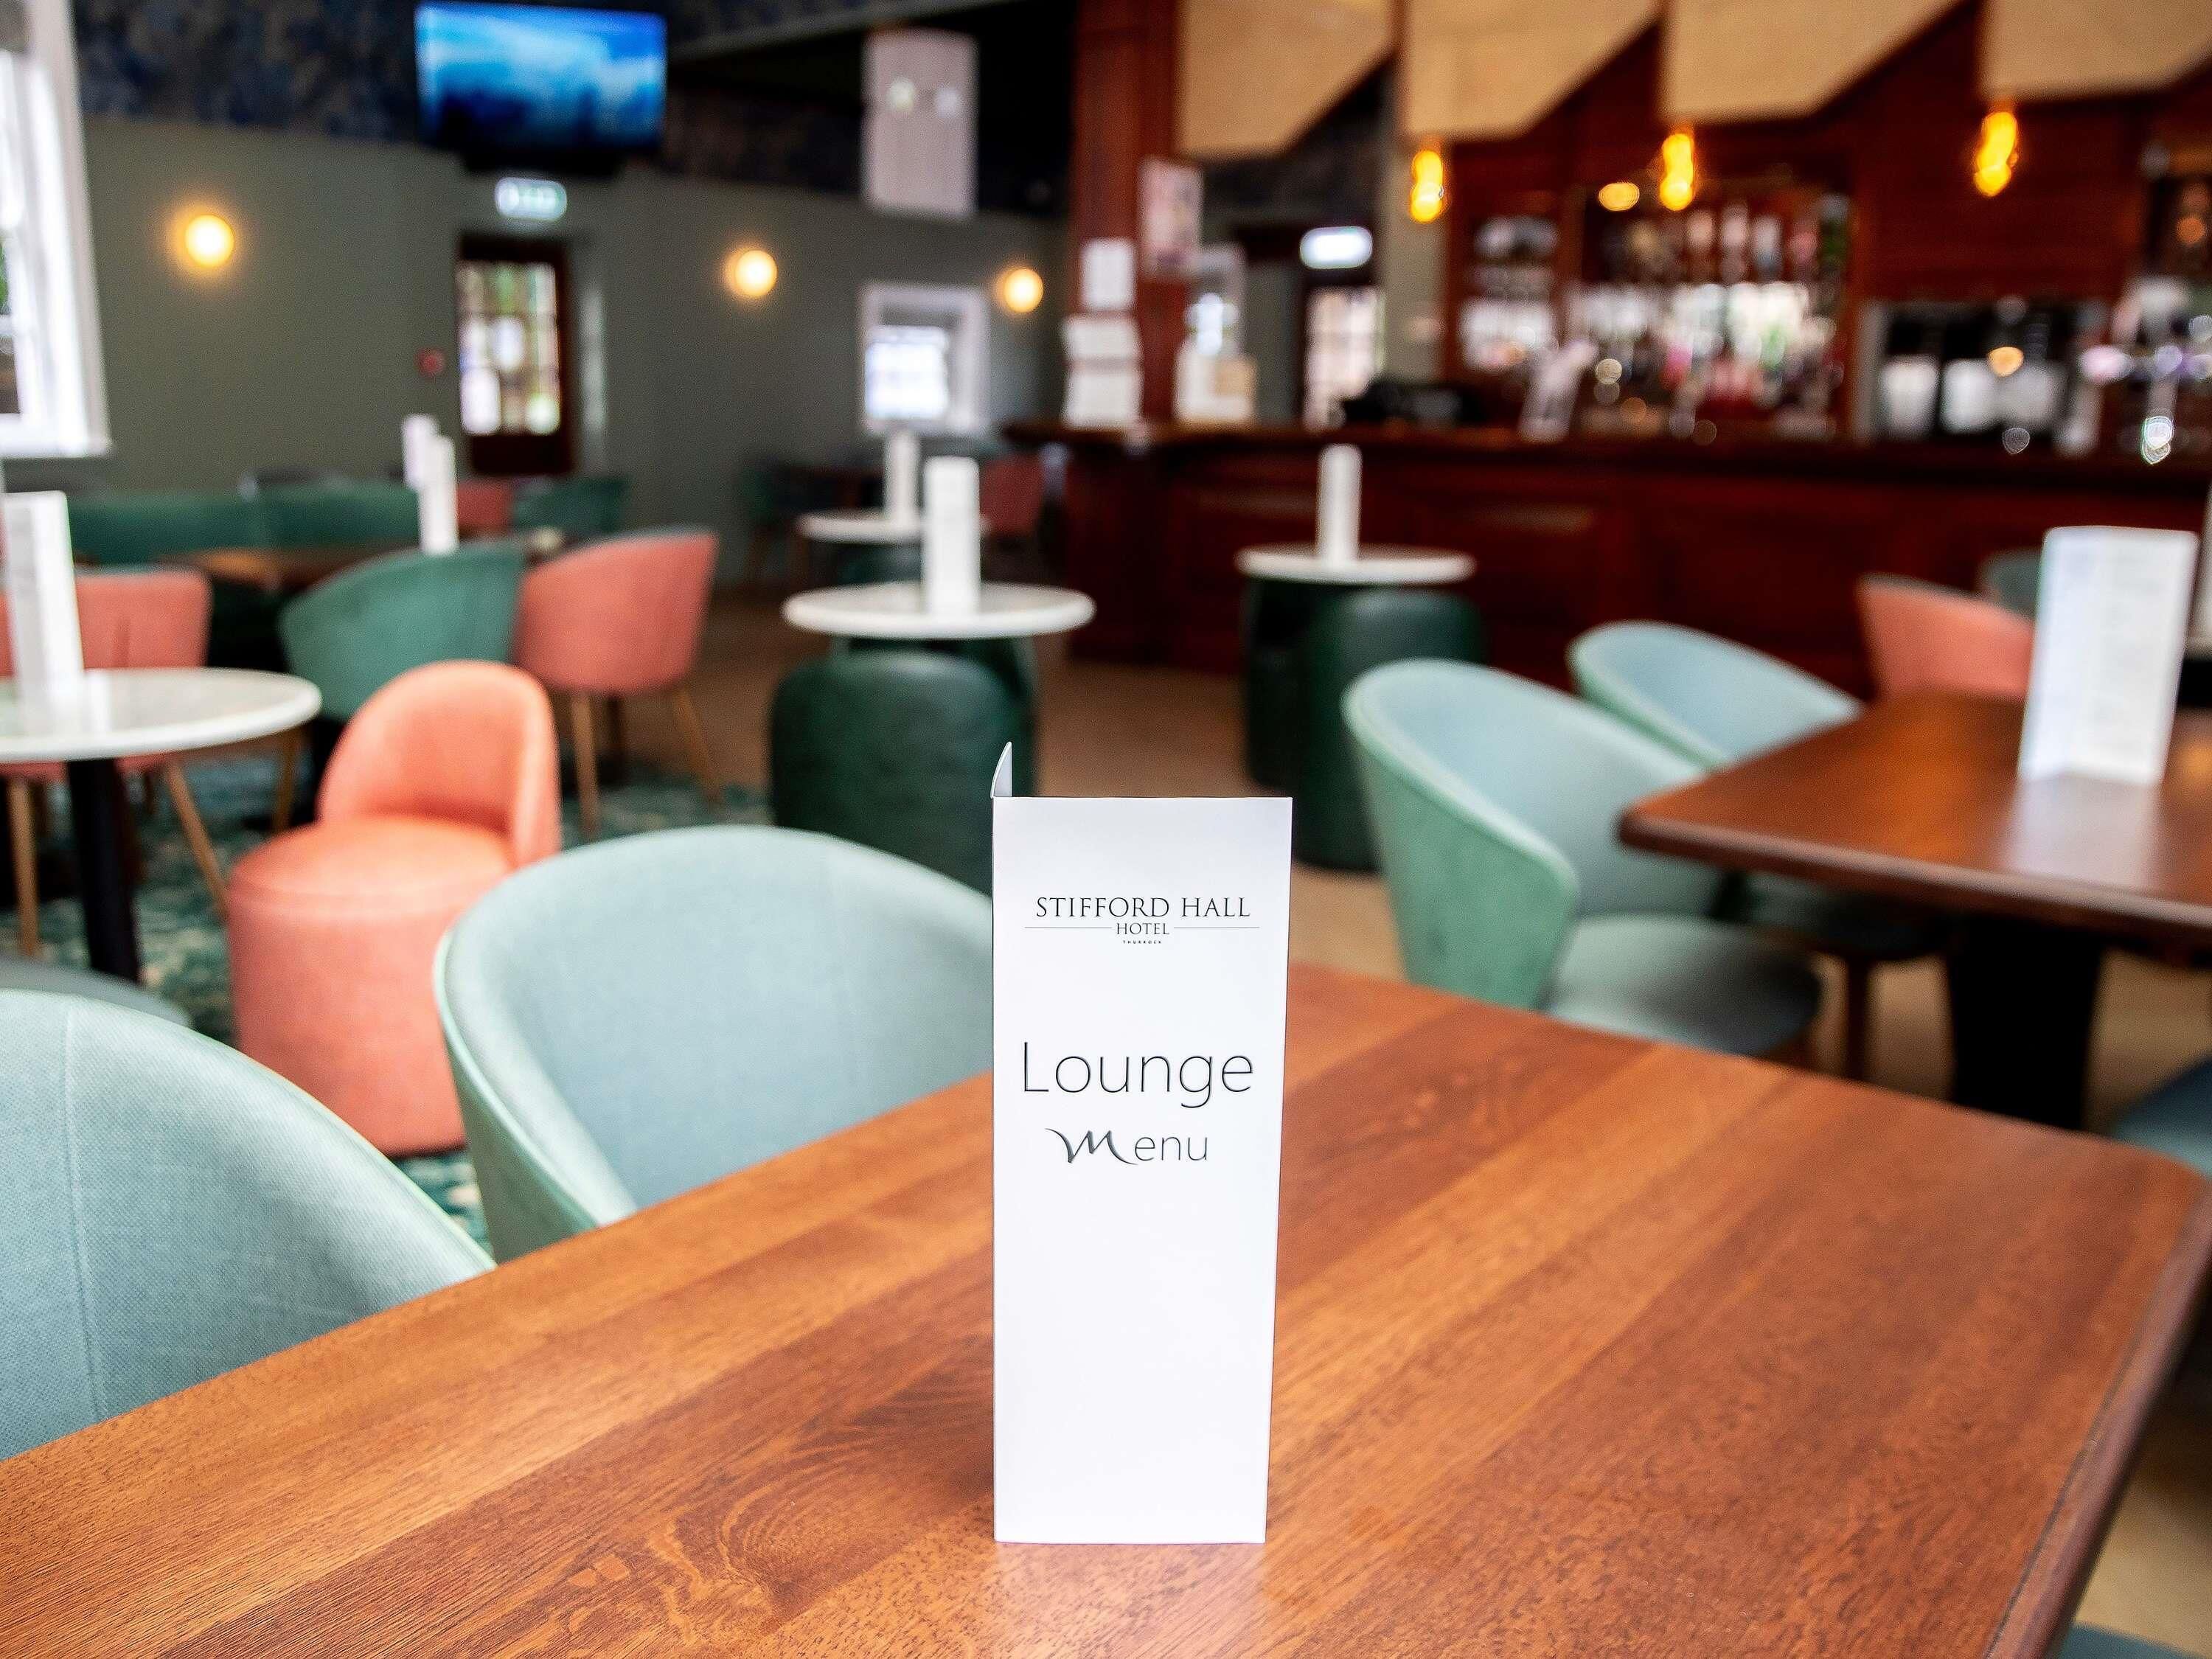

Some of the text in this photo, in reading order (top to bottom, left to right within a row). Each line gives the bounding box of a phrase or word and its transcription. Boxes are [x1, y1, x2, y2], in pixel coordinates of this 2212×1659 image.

[1036, 897, 1251, 918] STIFFORD HALL
[1116, 922, 1169, 935] HOTEL
[1023, 1041, 1253, 1109] Lounge
[1045, 1127, 1208, 1166] Menu
